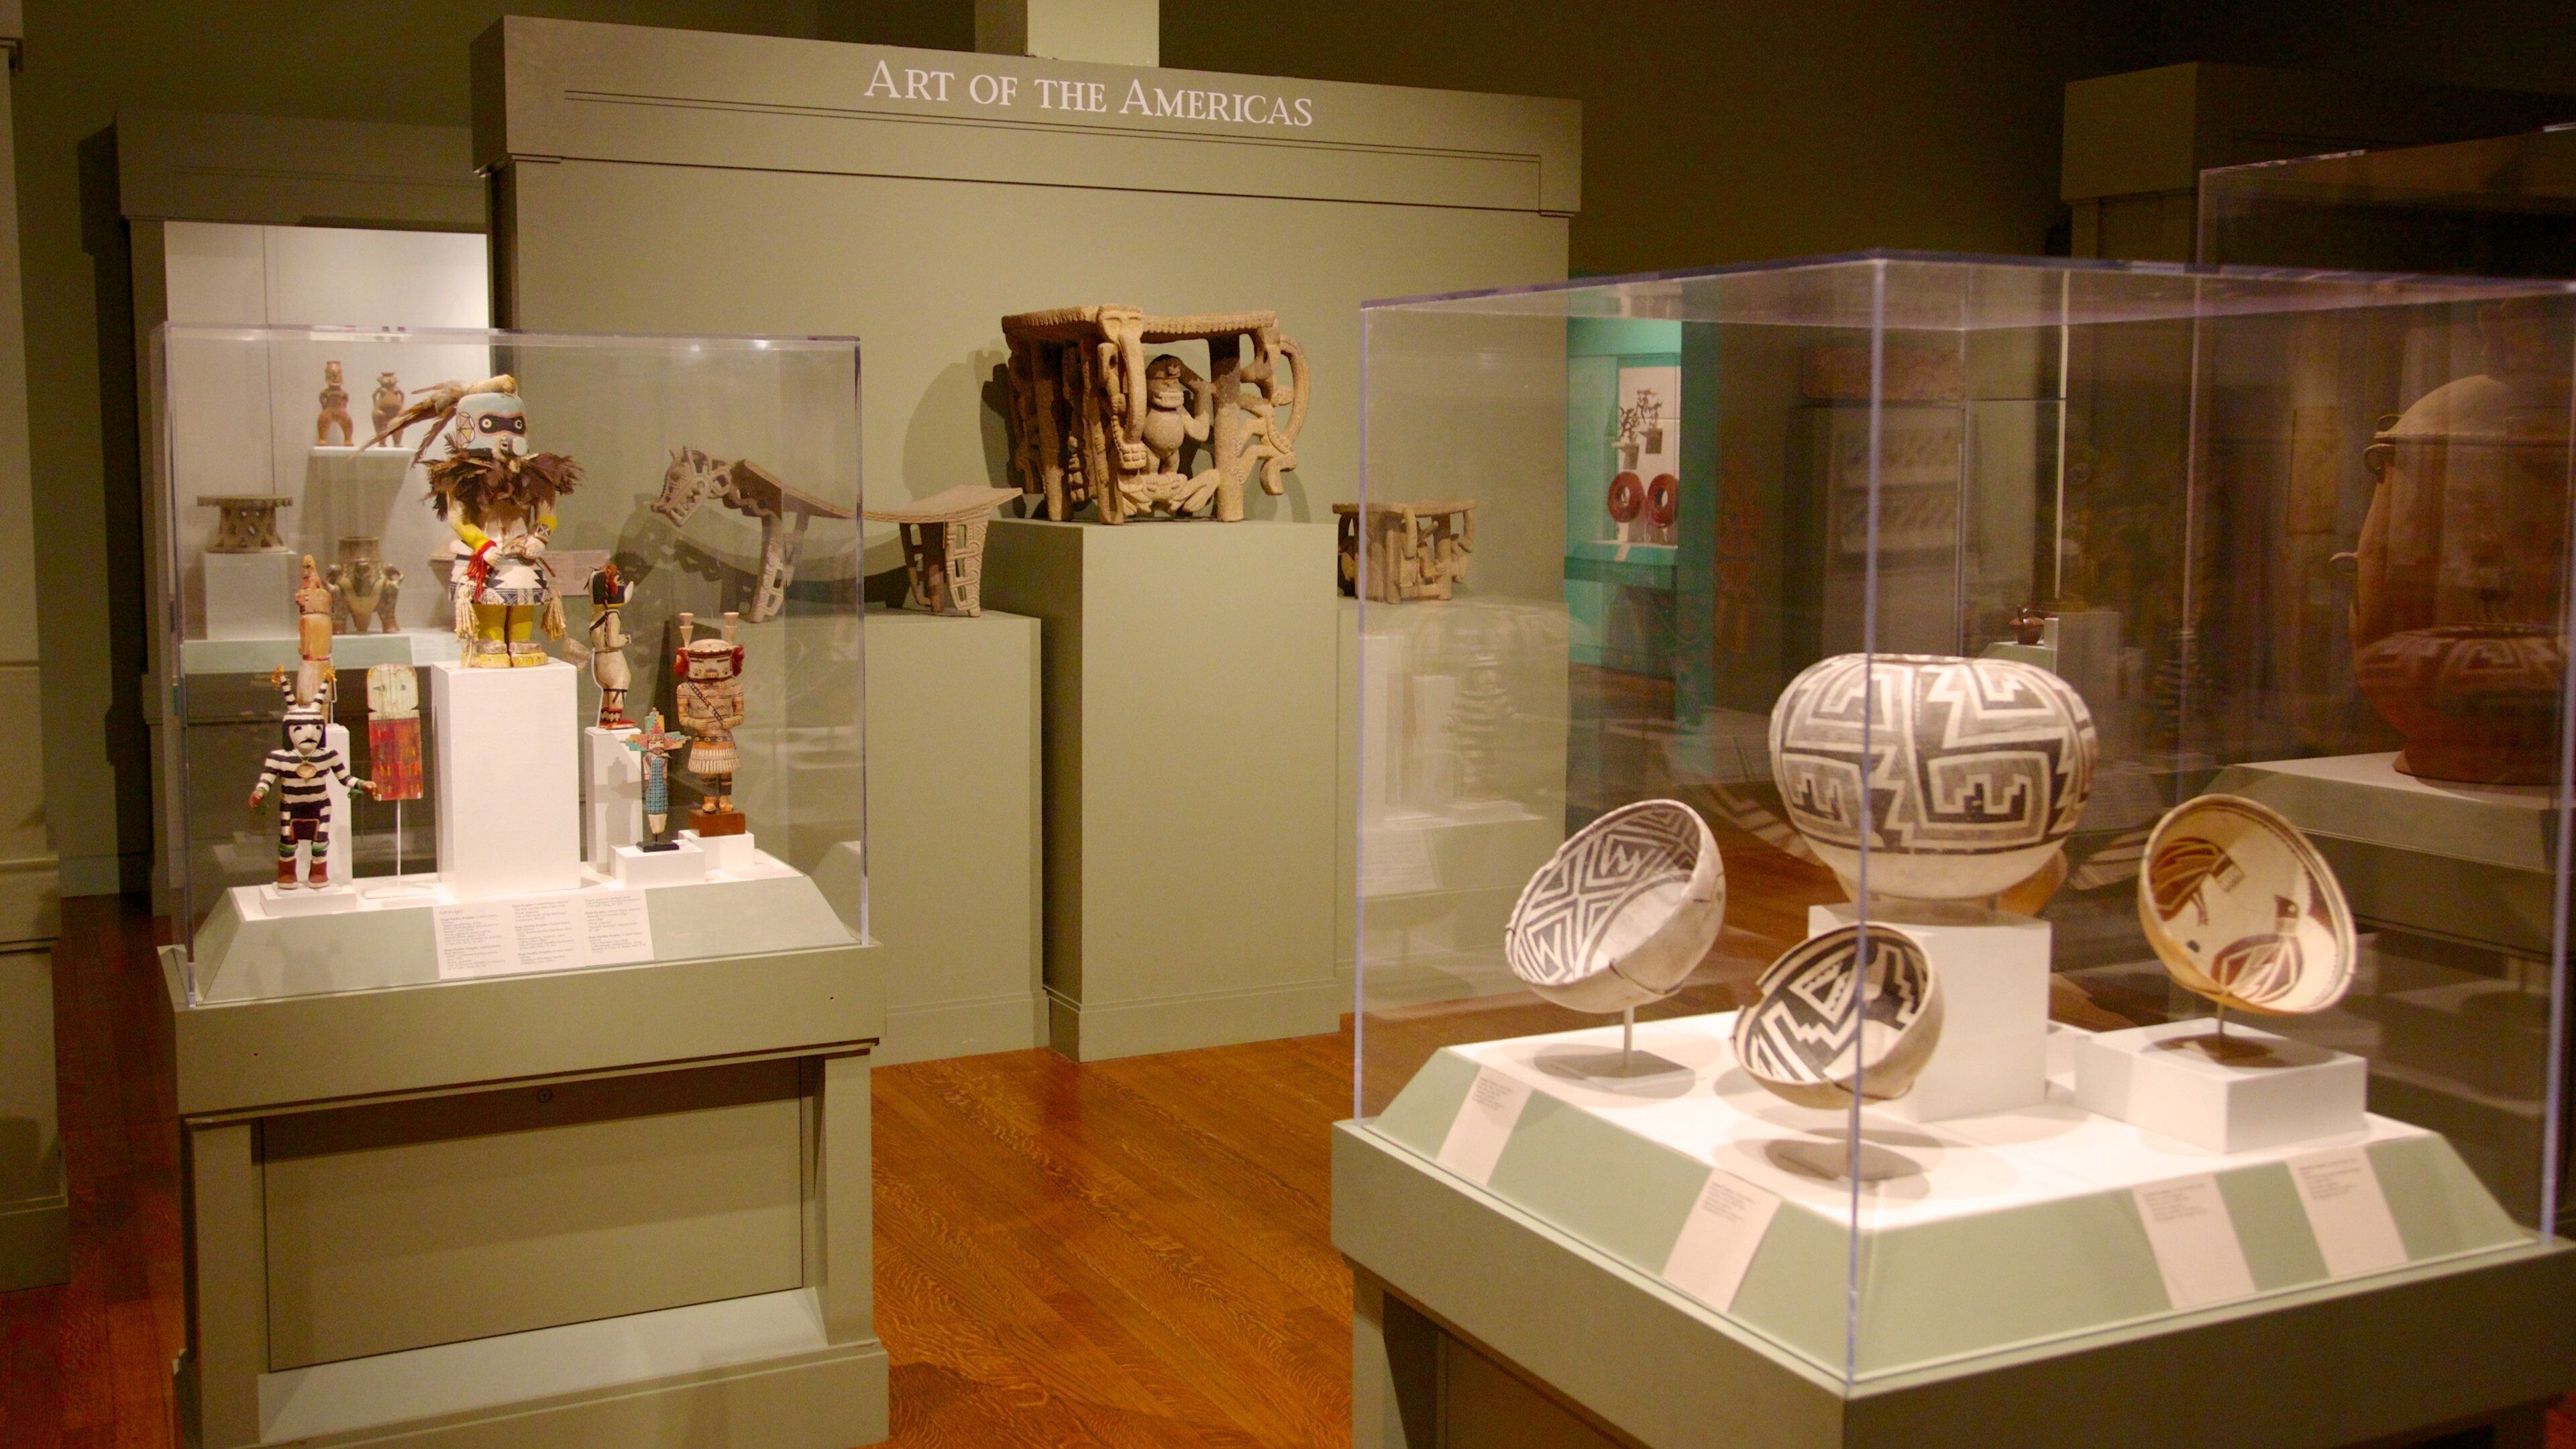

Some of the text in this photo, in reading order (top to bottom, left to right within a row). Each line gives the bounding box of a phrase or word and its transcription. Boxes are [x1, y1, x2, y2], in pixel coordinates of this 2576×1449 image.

[864, 59, 1313, 127] ART OF THE AMERICAS
